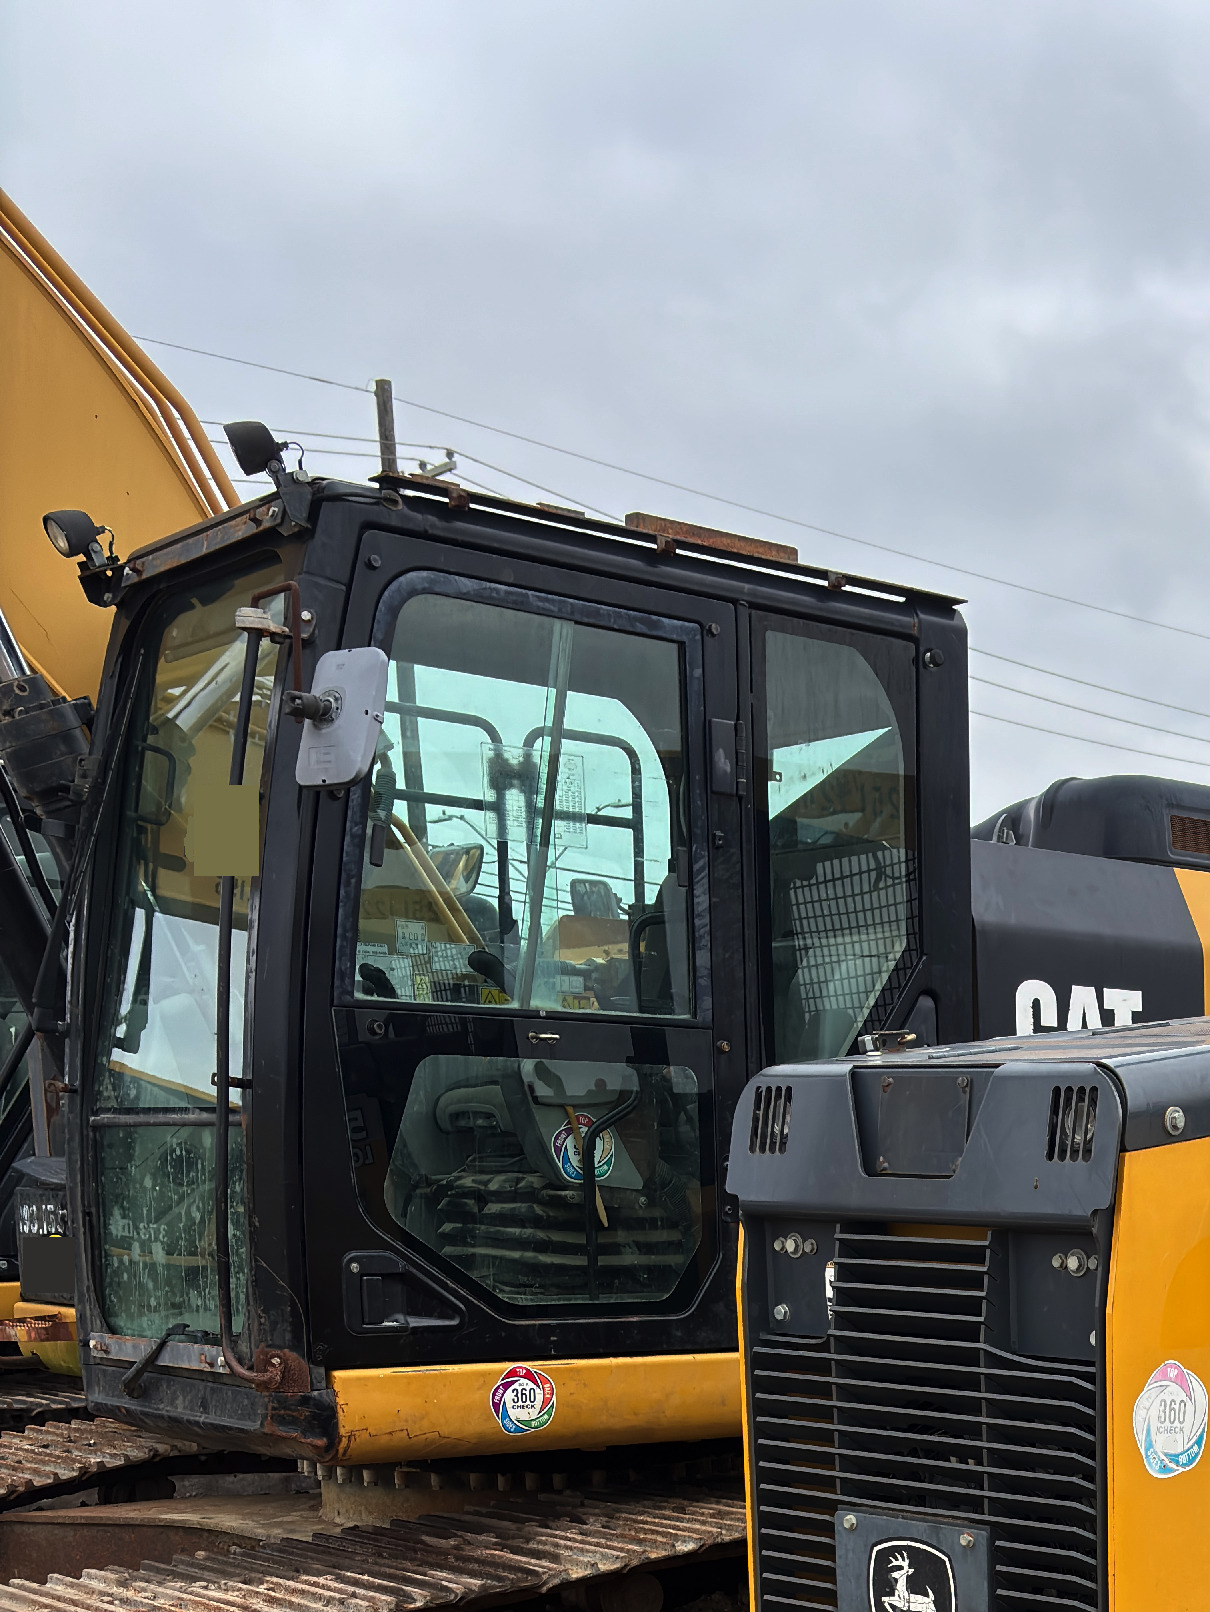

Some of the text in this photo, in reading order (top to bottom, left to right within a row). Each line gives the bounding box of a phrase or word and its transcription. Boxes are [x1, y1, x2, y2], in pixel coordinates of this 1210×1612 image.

[1015, 979, 1143, 1037] CAT
[1167, 1367, 1179, 1379] TOP
[511, 1387, 537, 1404] 360
[1159, 1399, 1187, 1425] 360
[1158, 1425, 1185, 1435] CHECK
[1147, 1448, 1161, 1470] SIDES
[1178, 1444, 1200, 1466] BOTTOM
